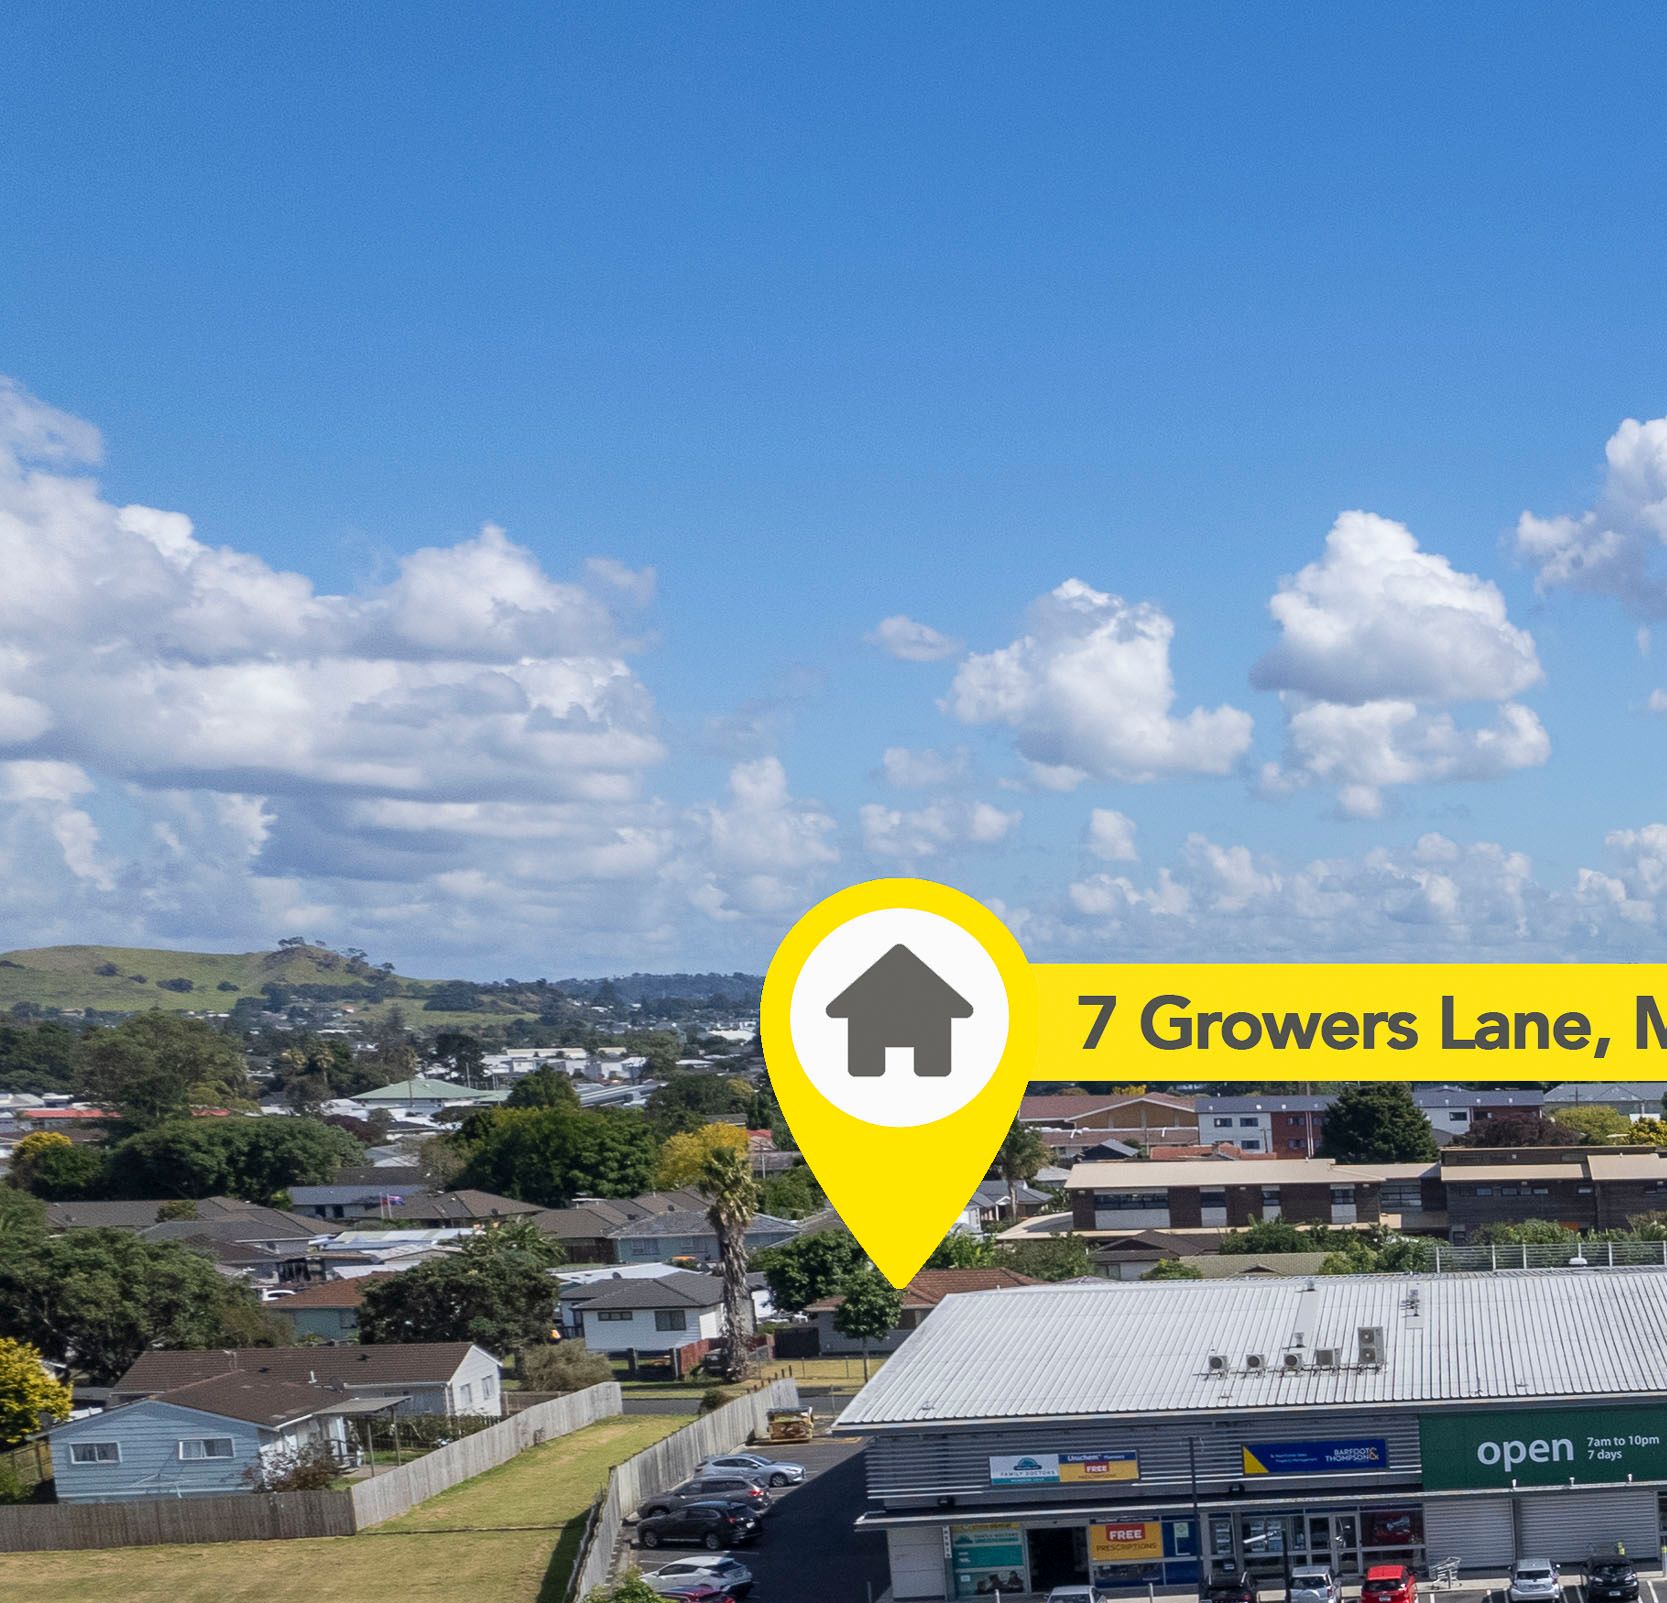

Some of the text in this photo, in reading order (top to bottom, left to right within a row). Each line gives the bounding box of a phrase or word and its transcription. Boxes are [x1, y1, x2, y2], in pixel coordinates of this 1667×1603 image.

[1587, 1435, 1660, 1448] 7am to 10pm
[1334, 1448, 1369, 1456] BARFOOT
[1477, 1438, 1574, 1472] open
[1587, 1449, 1623, 1460] 7 days
[1325, 1454, 1369, 1463] THOMPSON
[1086, 1465, 1107, 1473] FREE
[1109, 1530, 1142, 1540] FREE
[1096, 1542, 1157, 1552] PRESCRIPTIONS
